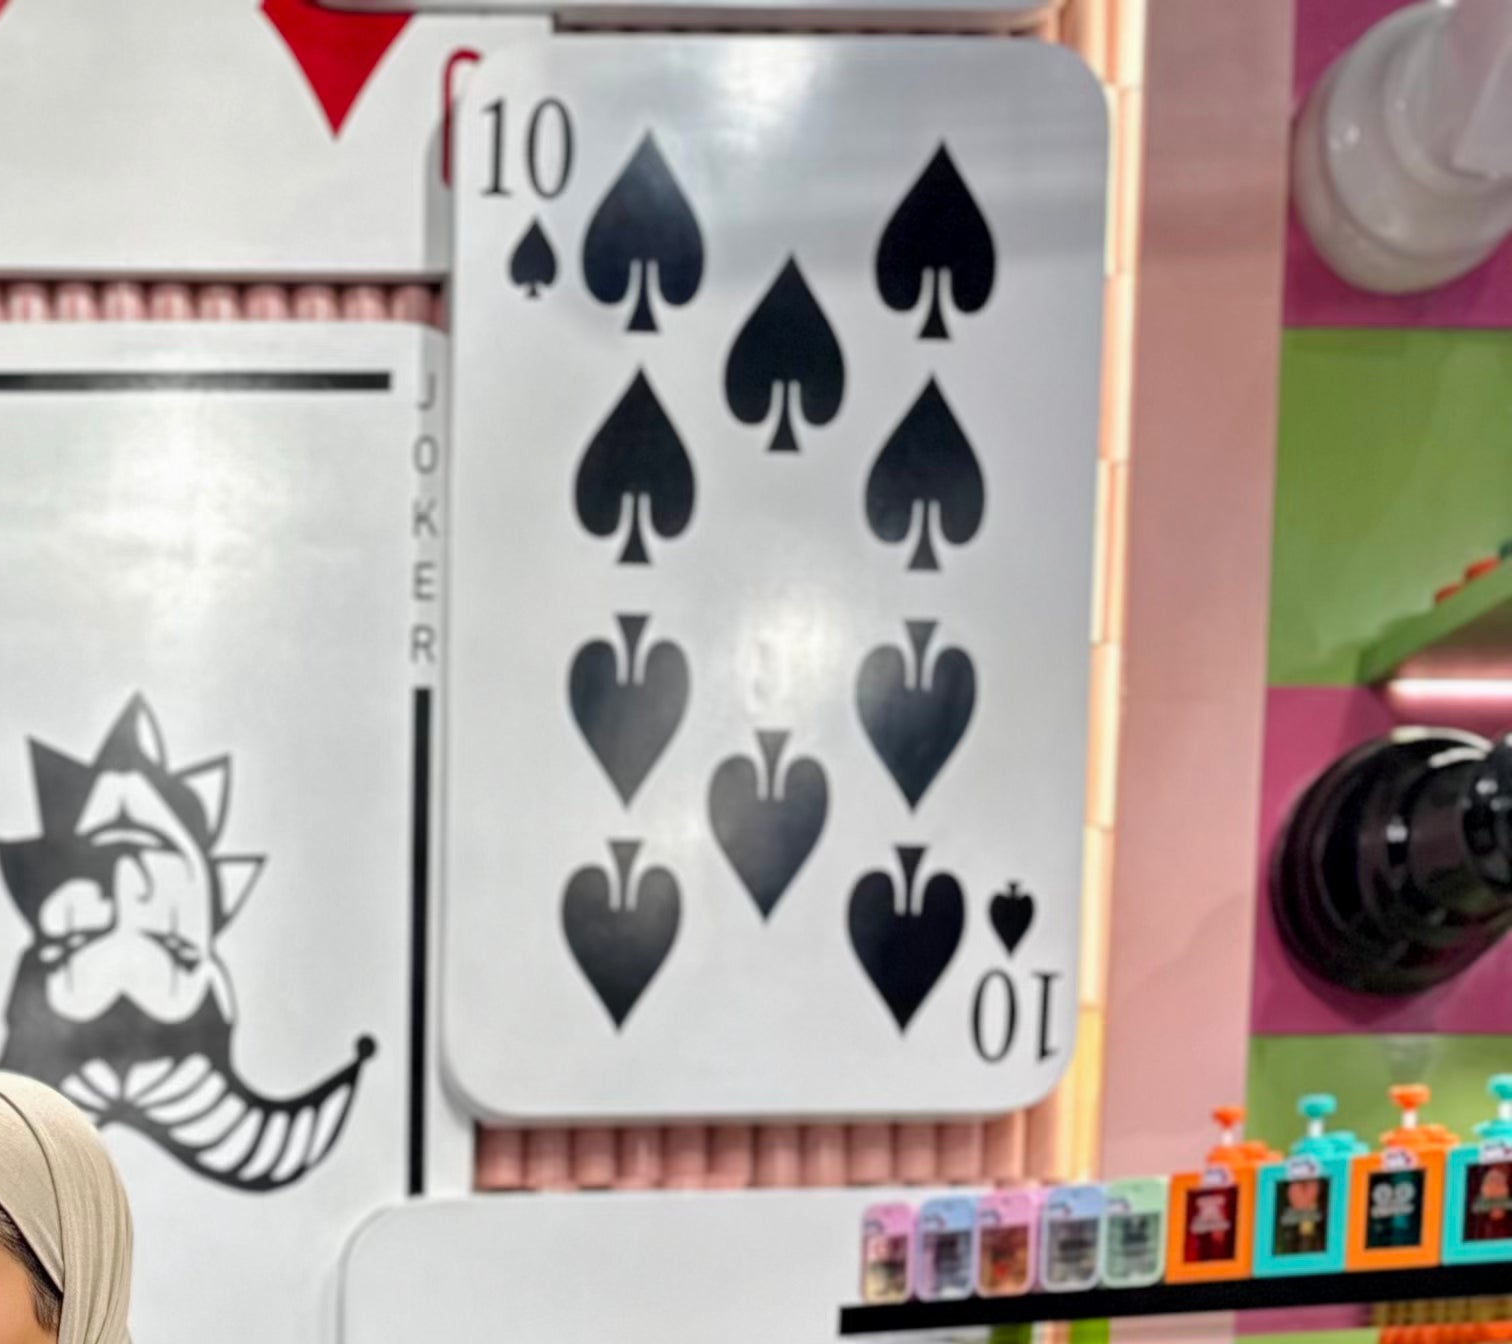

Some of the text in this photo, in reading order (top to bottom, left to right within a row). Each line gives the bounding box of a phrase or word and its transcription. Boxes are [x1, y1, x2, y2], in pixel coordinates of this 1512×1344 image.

[480, 97, 575, 200] 10
[410, 373, 439, 664] JOKER
[971, 967, 1062, 1064] 10
